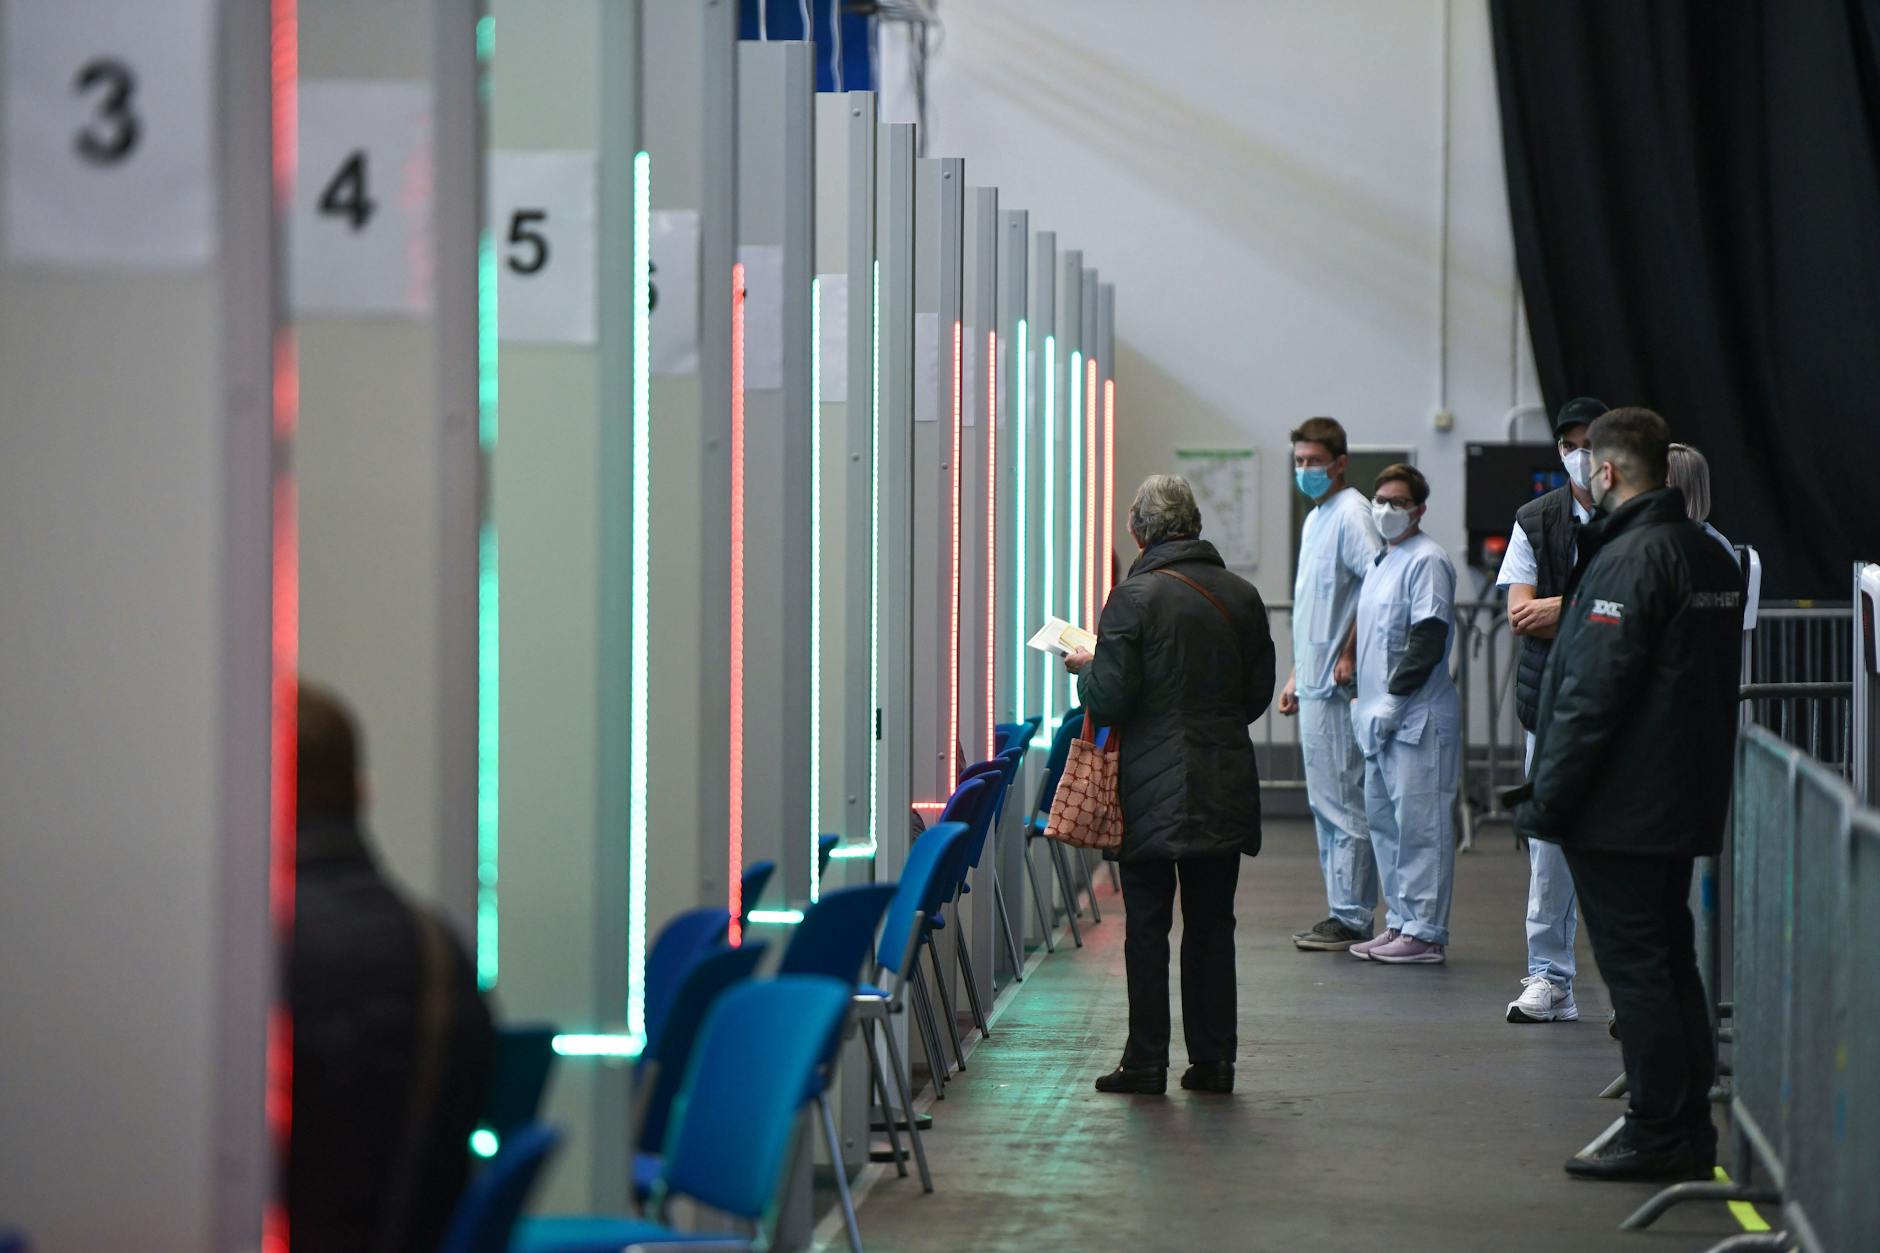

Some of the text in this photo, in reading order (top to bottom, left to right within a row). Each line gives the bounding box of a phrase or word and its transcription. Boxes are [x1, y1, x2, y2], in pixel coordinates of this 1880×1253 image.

[74, 58, 141, 166] 3
[317, 150, 376, 232] 4
[508, 209, 549, 275] 5
